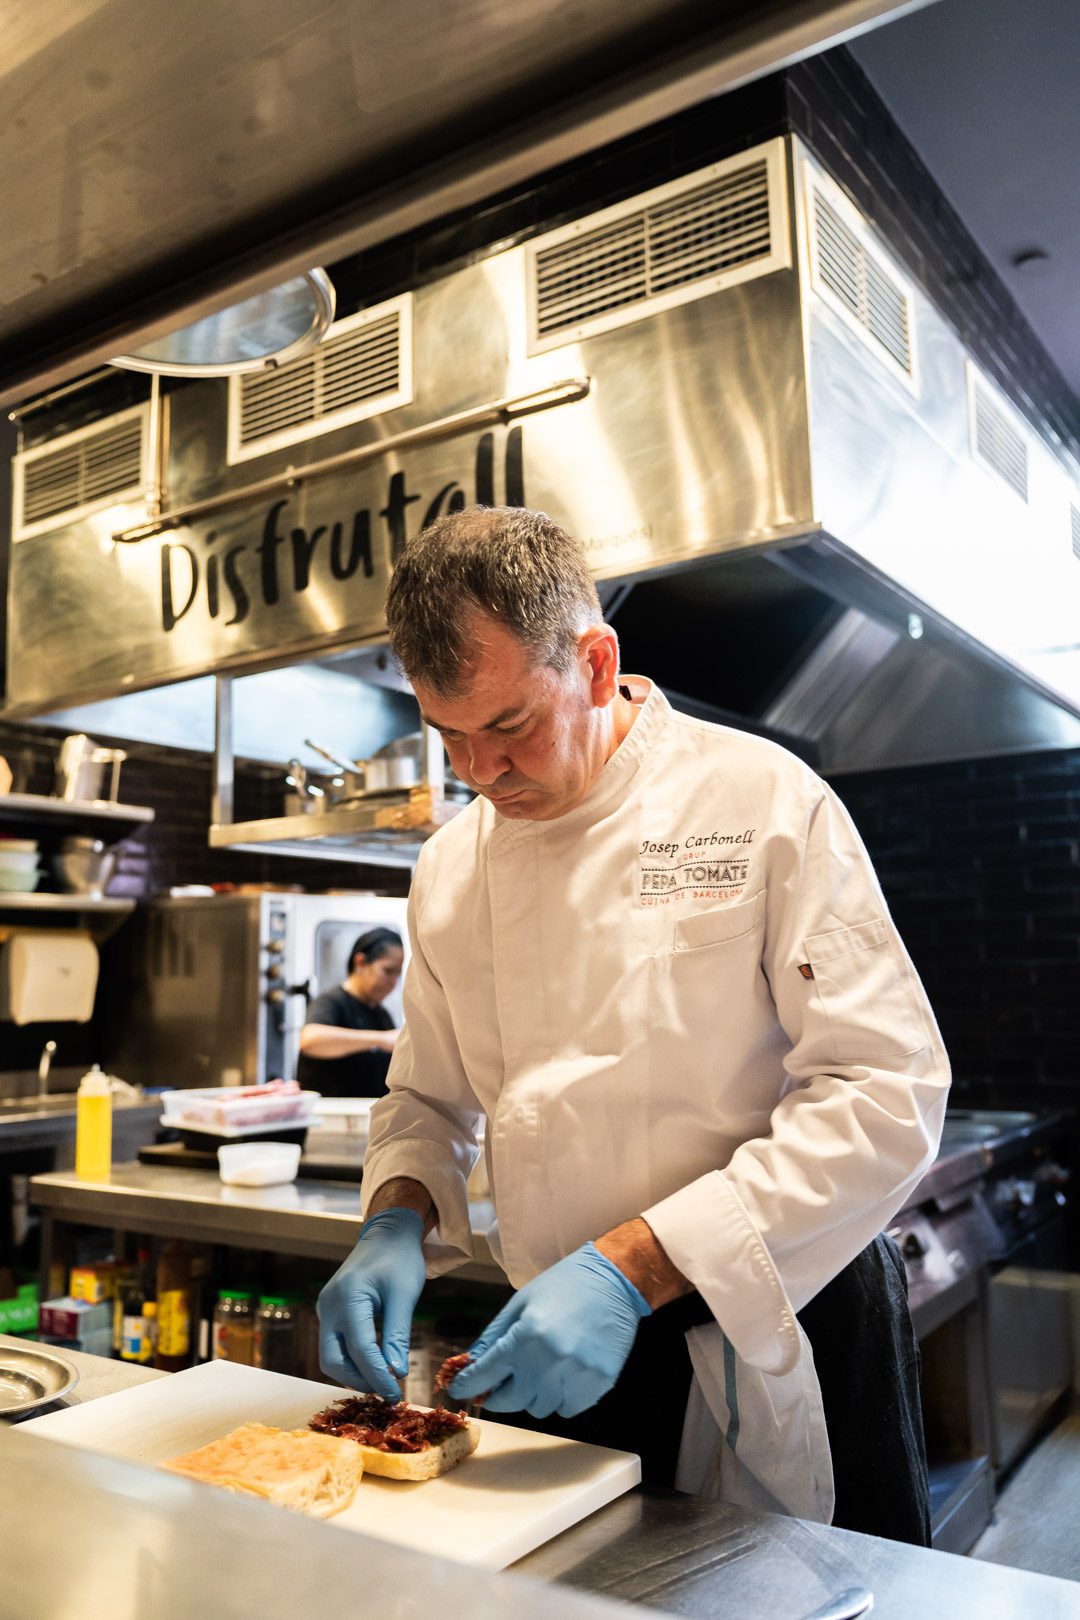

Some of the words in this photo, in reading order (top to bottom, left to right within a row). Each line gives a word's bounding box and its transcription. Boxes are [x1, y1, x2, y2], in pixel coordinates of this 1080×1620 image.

[639, 840, 679, 858] Josep
[685, 829, 756, 849] Carbonell
[682, 851, 706, 861] GRUP
[642, 873, 677, 890] PEPA
[684, 865, 748, 883] TOMATE
[675, 892, 685, 900] DE
